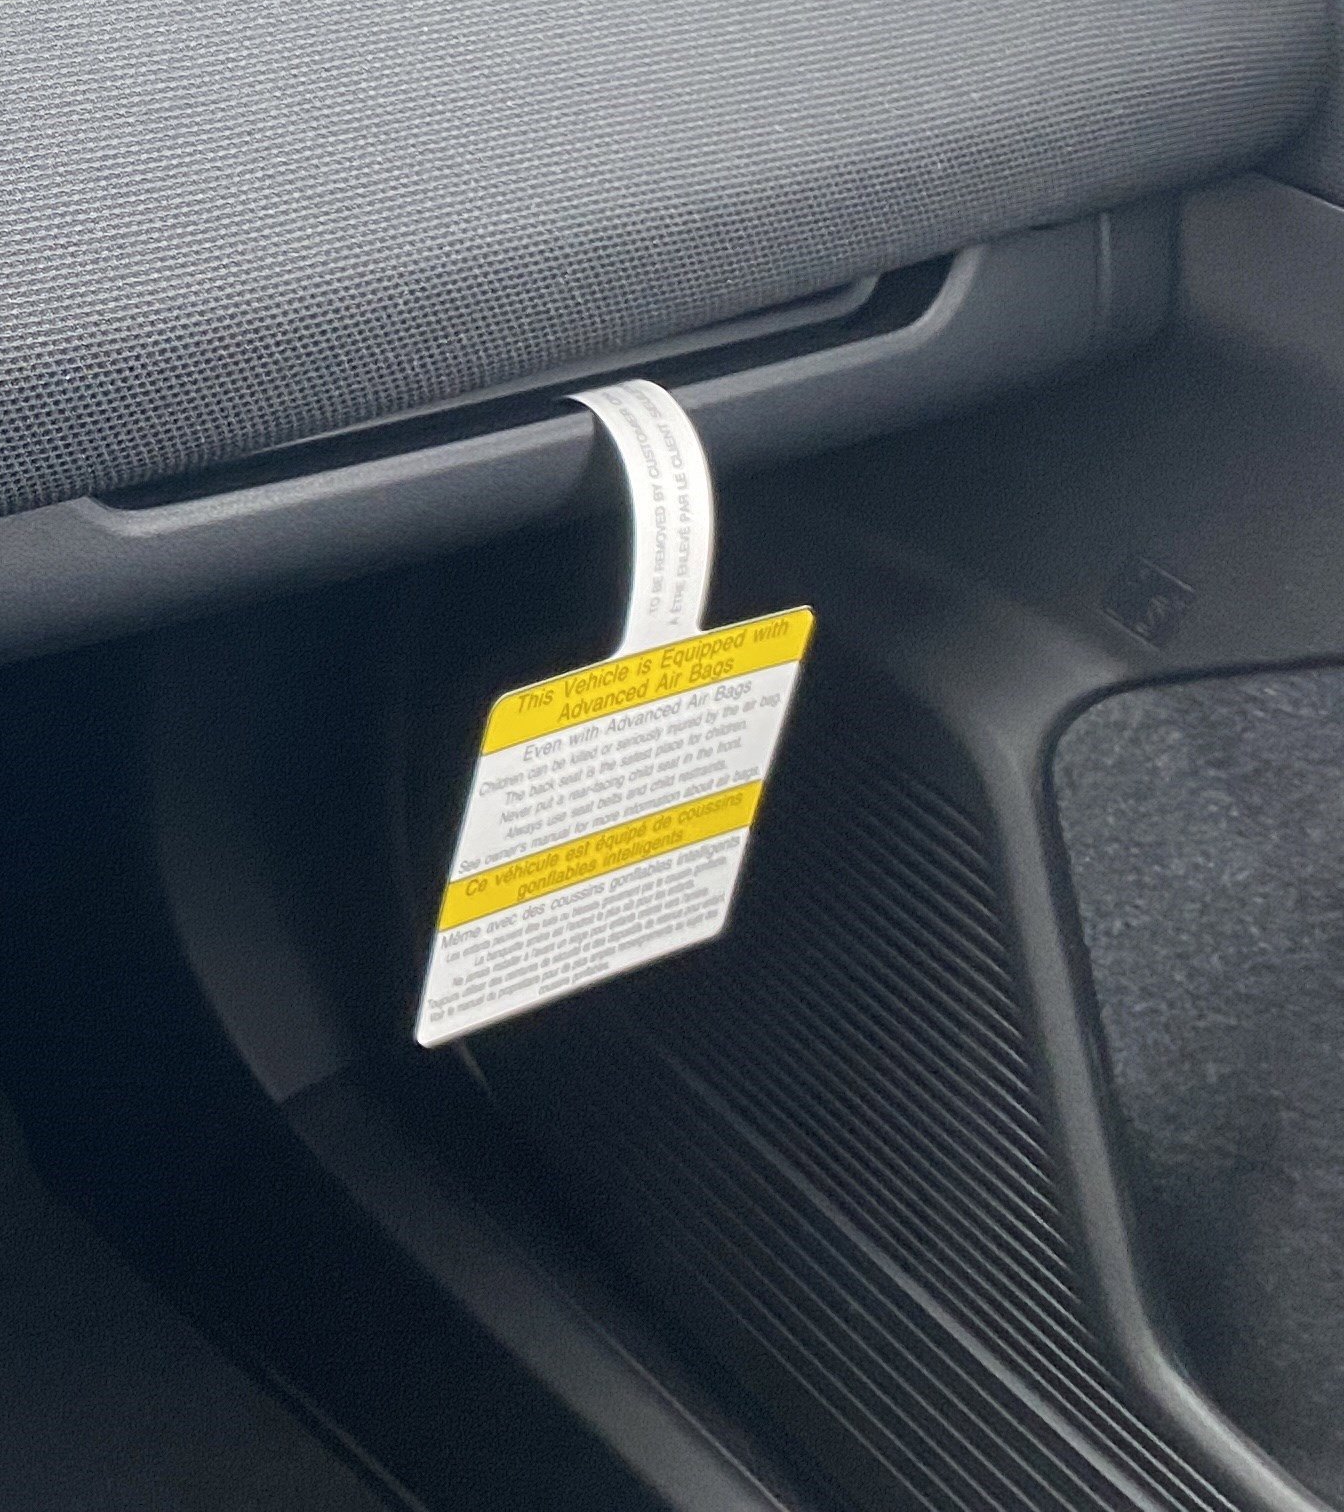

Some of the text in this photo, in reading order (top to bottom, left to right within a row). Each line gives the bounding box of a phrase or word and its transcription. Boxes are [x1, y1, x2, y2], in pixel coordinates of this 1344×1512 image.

[516, 617, 791, 713] This Vehicle is Equipped with
[557, 652, 736, 722] Advanced Air Bags
[522, 734, 564, 762] Even
